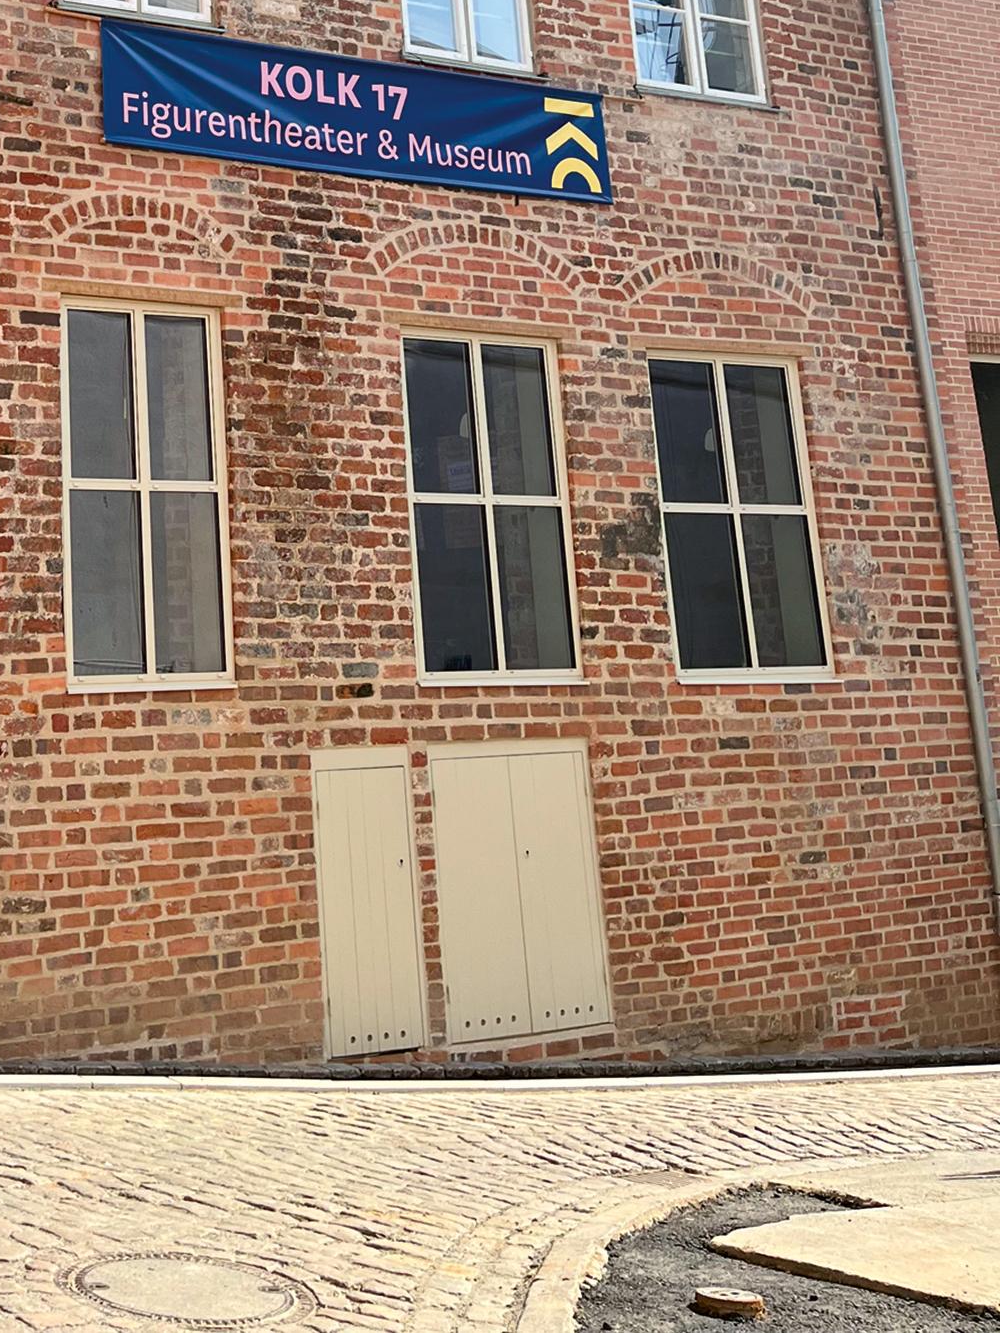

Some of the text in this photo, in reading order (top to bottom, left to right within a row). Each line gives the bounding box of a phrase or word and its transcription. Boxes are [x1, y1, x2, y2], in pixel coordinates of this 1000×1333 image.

[259, 60, 409, 121] KOLK 17
[121, 90, 533, 177] Figurentheater & Museum
